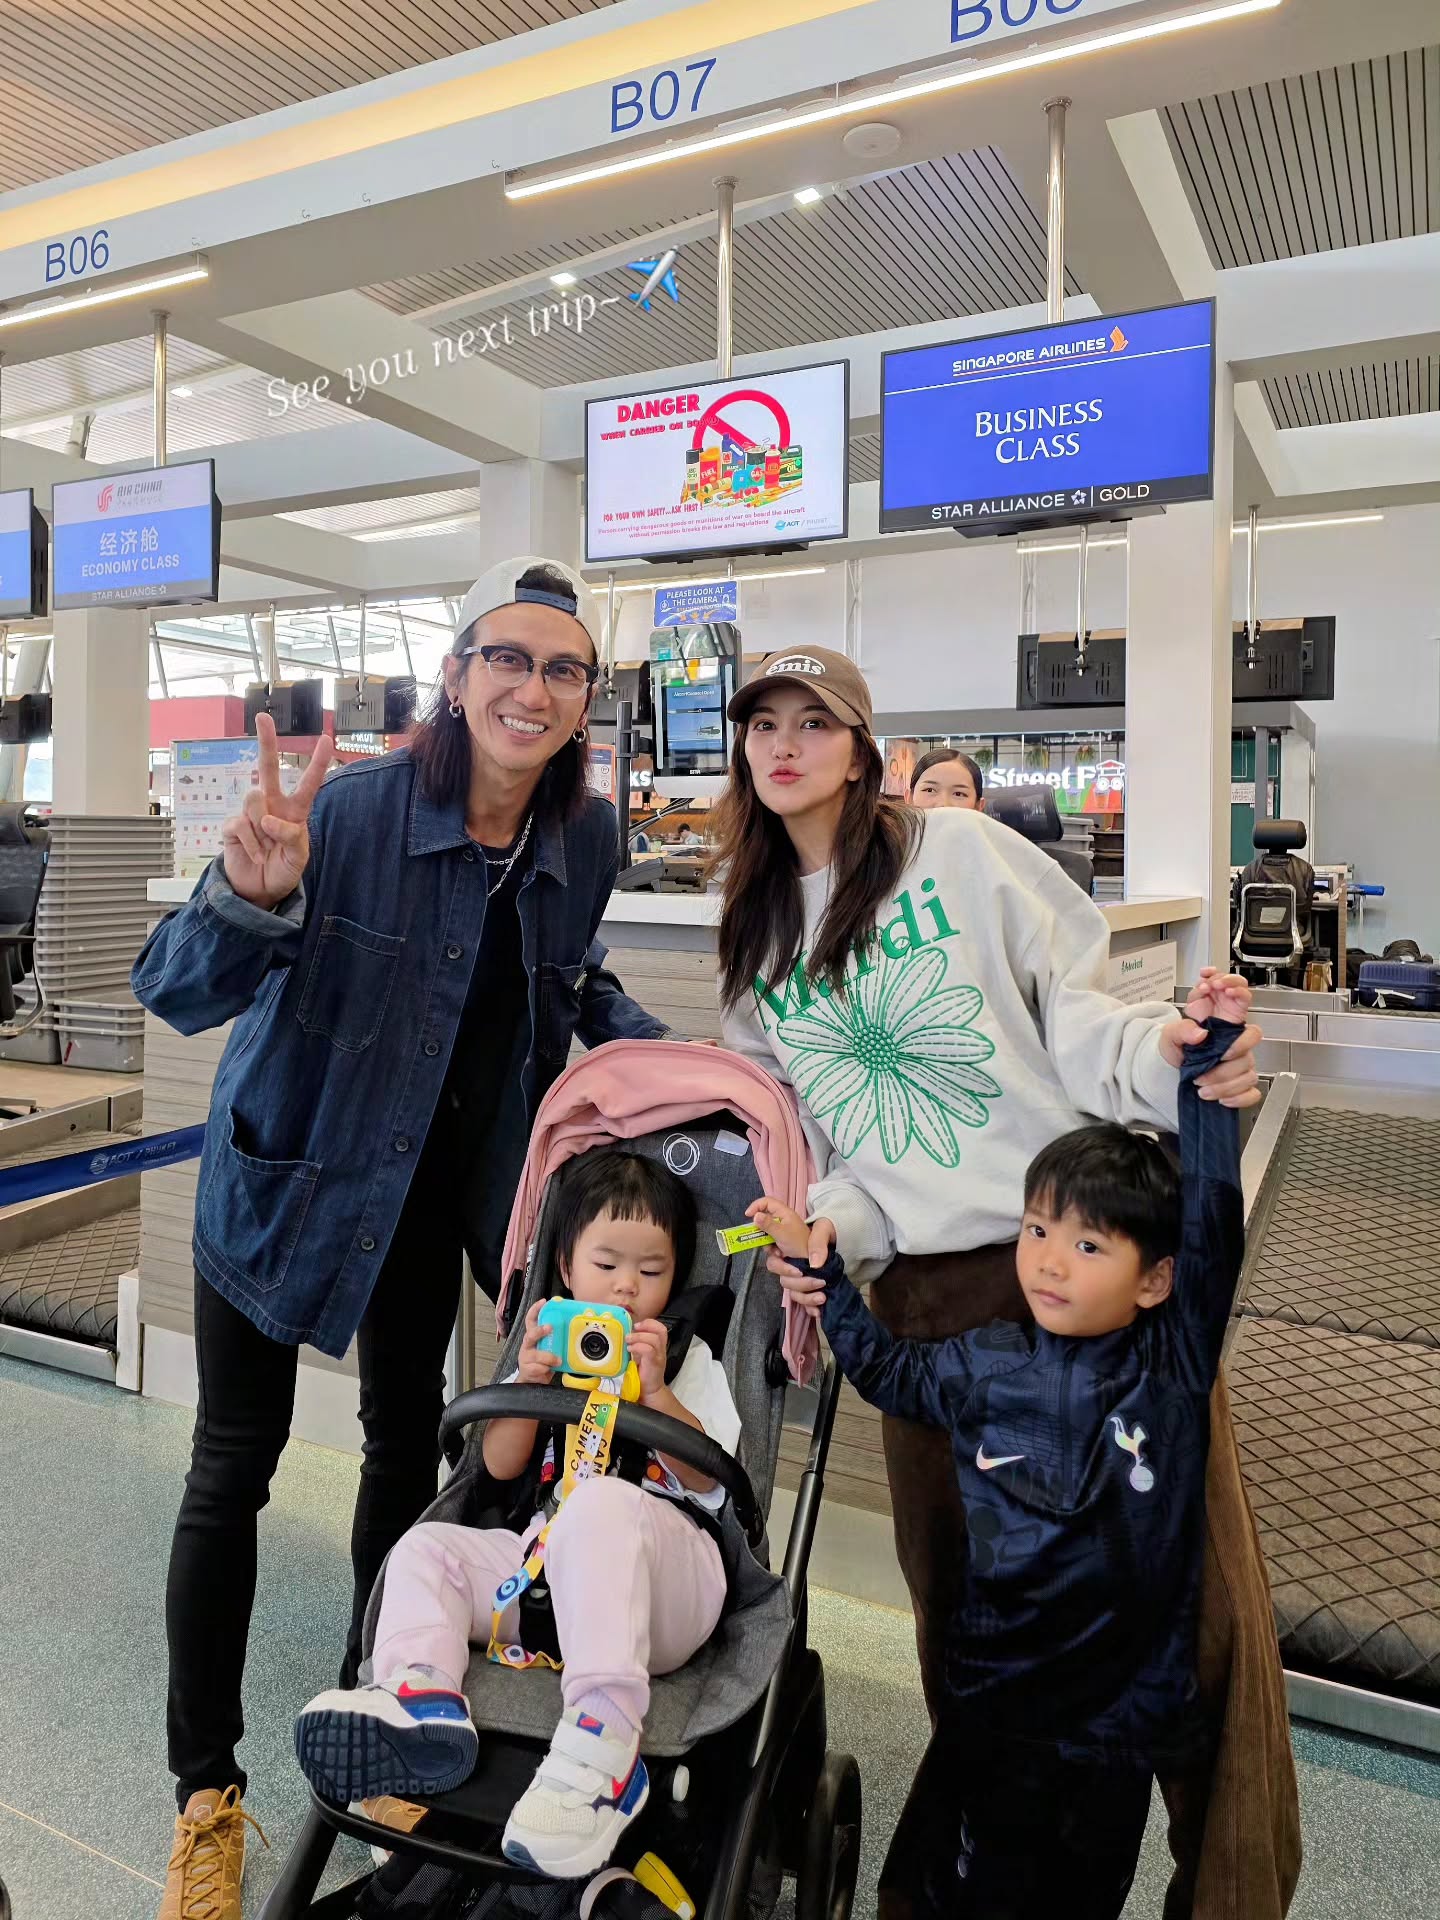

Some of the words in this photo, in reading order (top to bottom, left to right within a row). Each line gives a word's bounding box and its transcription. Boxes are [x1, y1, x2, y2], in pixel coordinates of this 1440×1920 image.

[611, 57, 717, 133] B07
[46, 229, 109, 282] B06
[952, 349, 1035, 373] SINGAPORE
[1039, 338, 1106, 358] AIRLINES
[617, 393, 700, 423] DANGER
[975, 398, 1103, 437] BUSINESS
[601, 430, 626, 441] WHEN
[629, 424, 665, 437] CARRIED
[669, 421, 683, 431] ON
[995, 432, 1080, 464] CLASS
[701, 468, 717, 479] FUEL
[117, 485, 133, 497] AIR
[134, 480, 163, 494] CHINA
[931, 503, 974, 520] STAR
[979, 494, 1065, 515] ALLIANCE
[1100, 484, 1150, 502] GOLD
[603, 513, 613, 523] FOR
[616, 511, 630, 521] YOUR
[632, 508, 646, 519] OWN
[684, 503, 698, 513] FIRST
[100, 526, 159, 557] 经济舱
[82, 559, 139, 577] ECONOMY
[141, 554, 180, 571] CLASS
[92, 591, 113, 601] STAR
[115, 586, 157, 599] ALLIANCE
[666, 590, 691, 599] PLEASE
[693, 588, 713, 596] LOOK
[673, 599, 686, 607] THE
[687, 595, 718, 604] CAMERA
[988, 766, 1071, 790] Street
[570, 1402, 601, 1472] CAMERA
